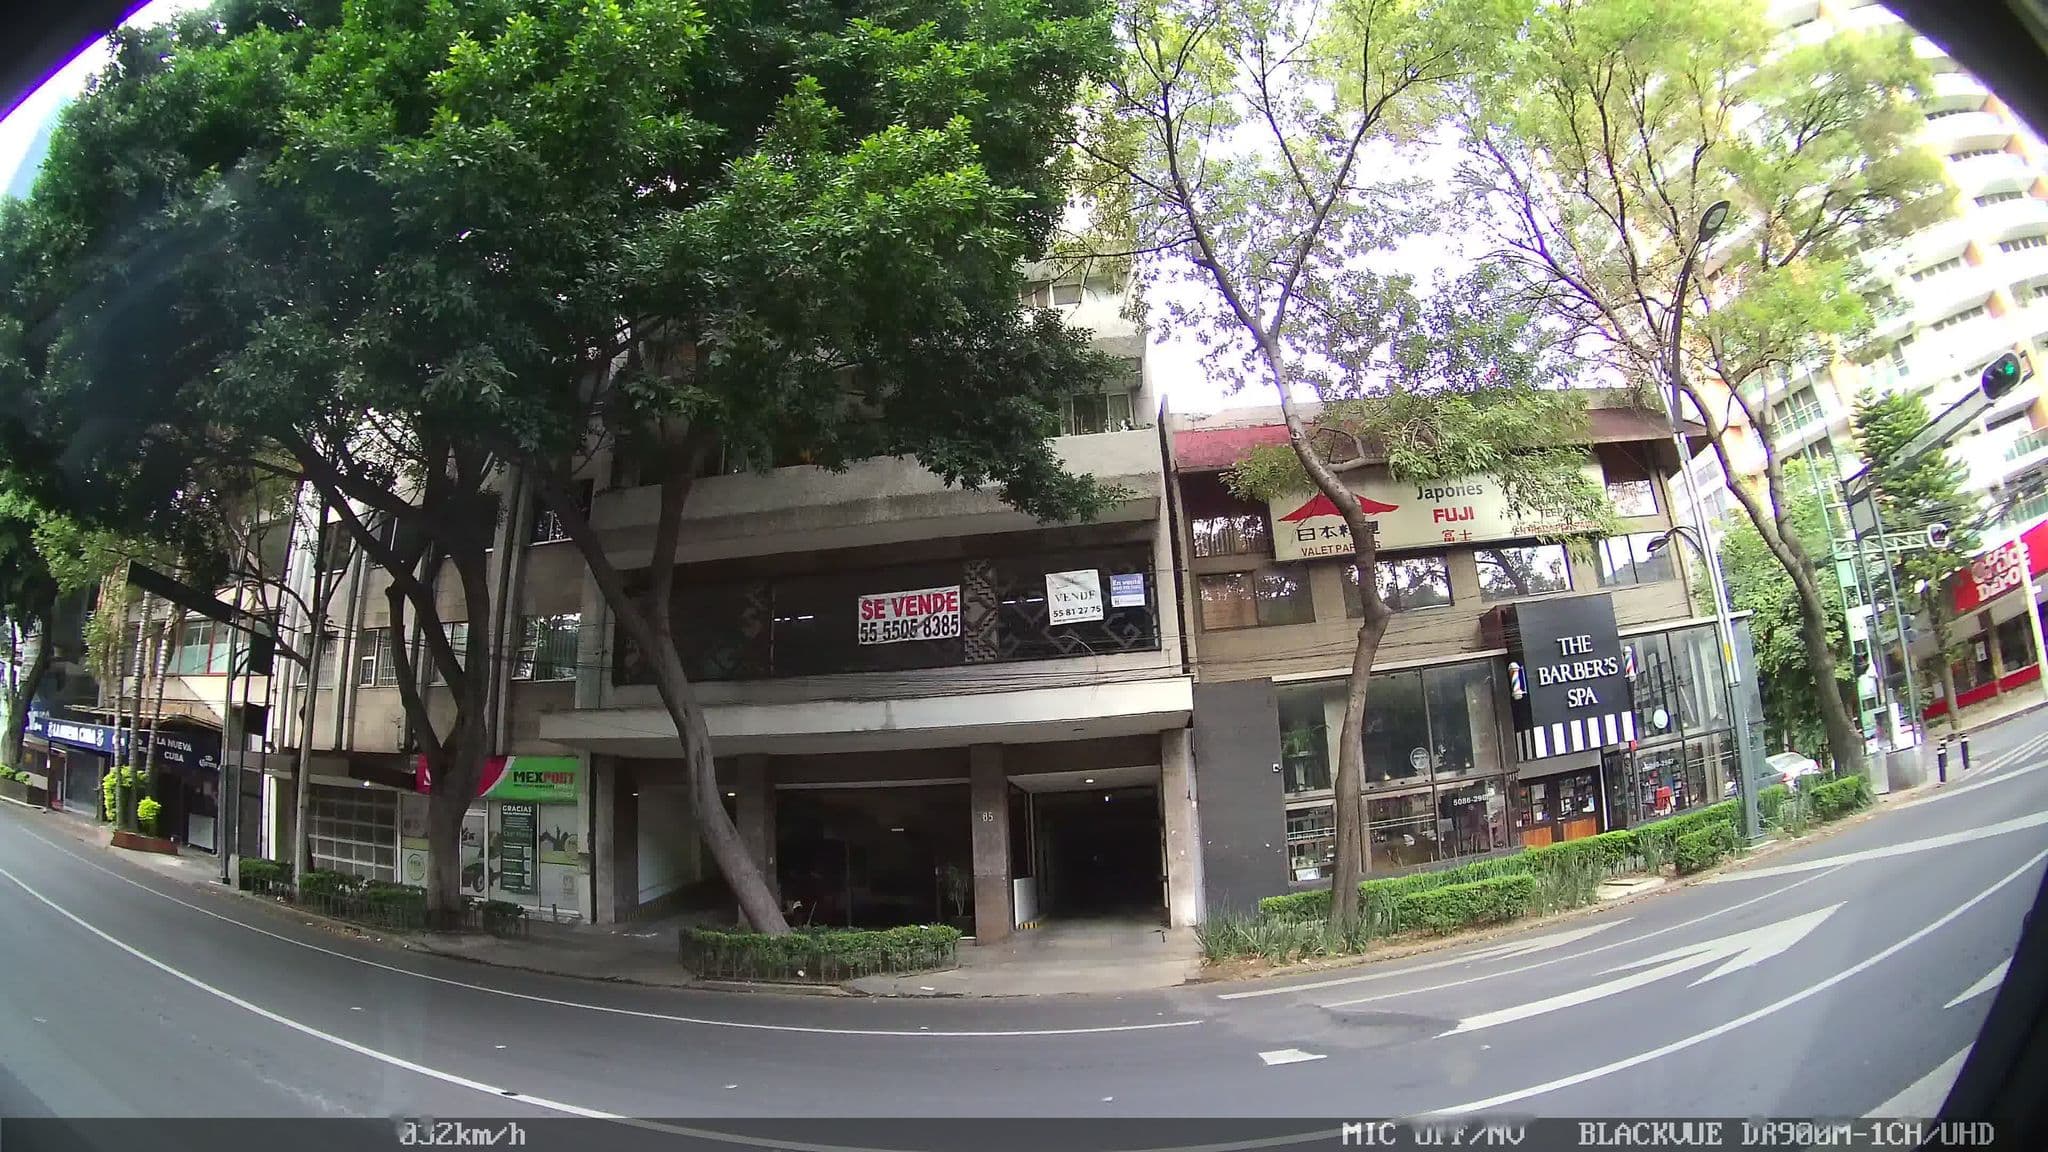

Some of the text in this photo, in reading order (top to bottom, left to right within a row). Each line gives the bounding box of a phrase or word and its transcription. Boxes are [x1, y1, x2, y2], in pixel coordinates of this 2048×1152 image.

[1432, 506, 1475, 523] FUJI
[1442, 528, 1472, 543] 富士
[1301, 540, 1381, 557] VALET PARG
[1976, 564, 2025, 602] DEPO
[861, 591, 958, 620] SE VENDE
[1053, 605, 1101, 617] 55 81 27 75
[860, 622, 877, 642] 55
[923, 614, 959, 638] 8385
[1556, 634, 1593, 656] THE
[1537, 656, 1619, 686] BARBER'S
[1567, 686, 1599, 708] SPA
[156, 736, 192, 752] LA NUEVA
[164, 751, 184, 763] CUBA
[502, 805, 532, 813] GRACIAS
